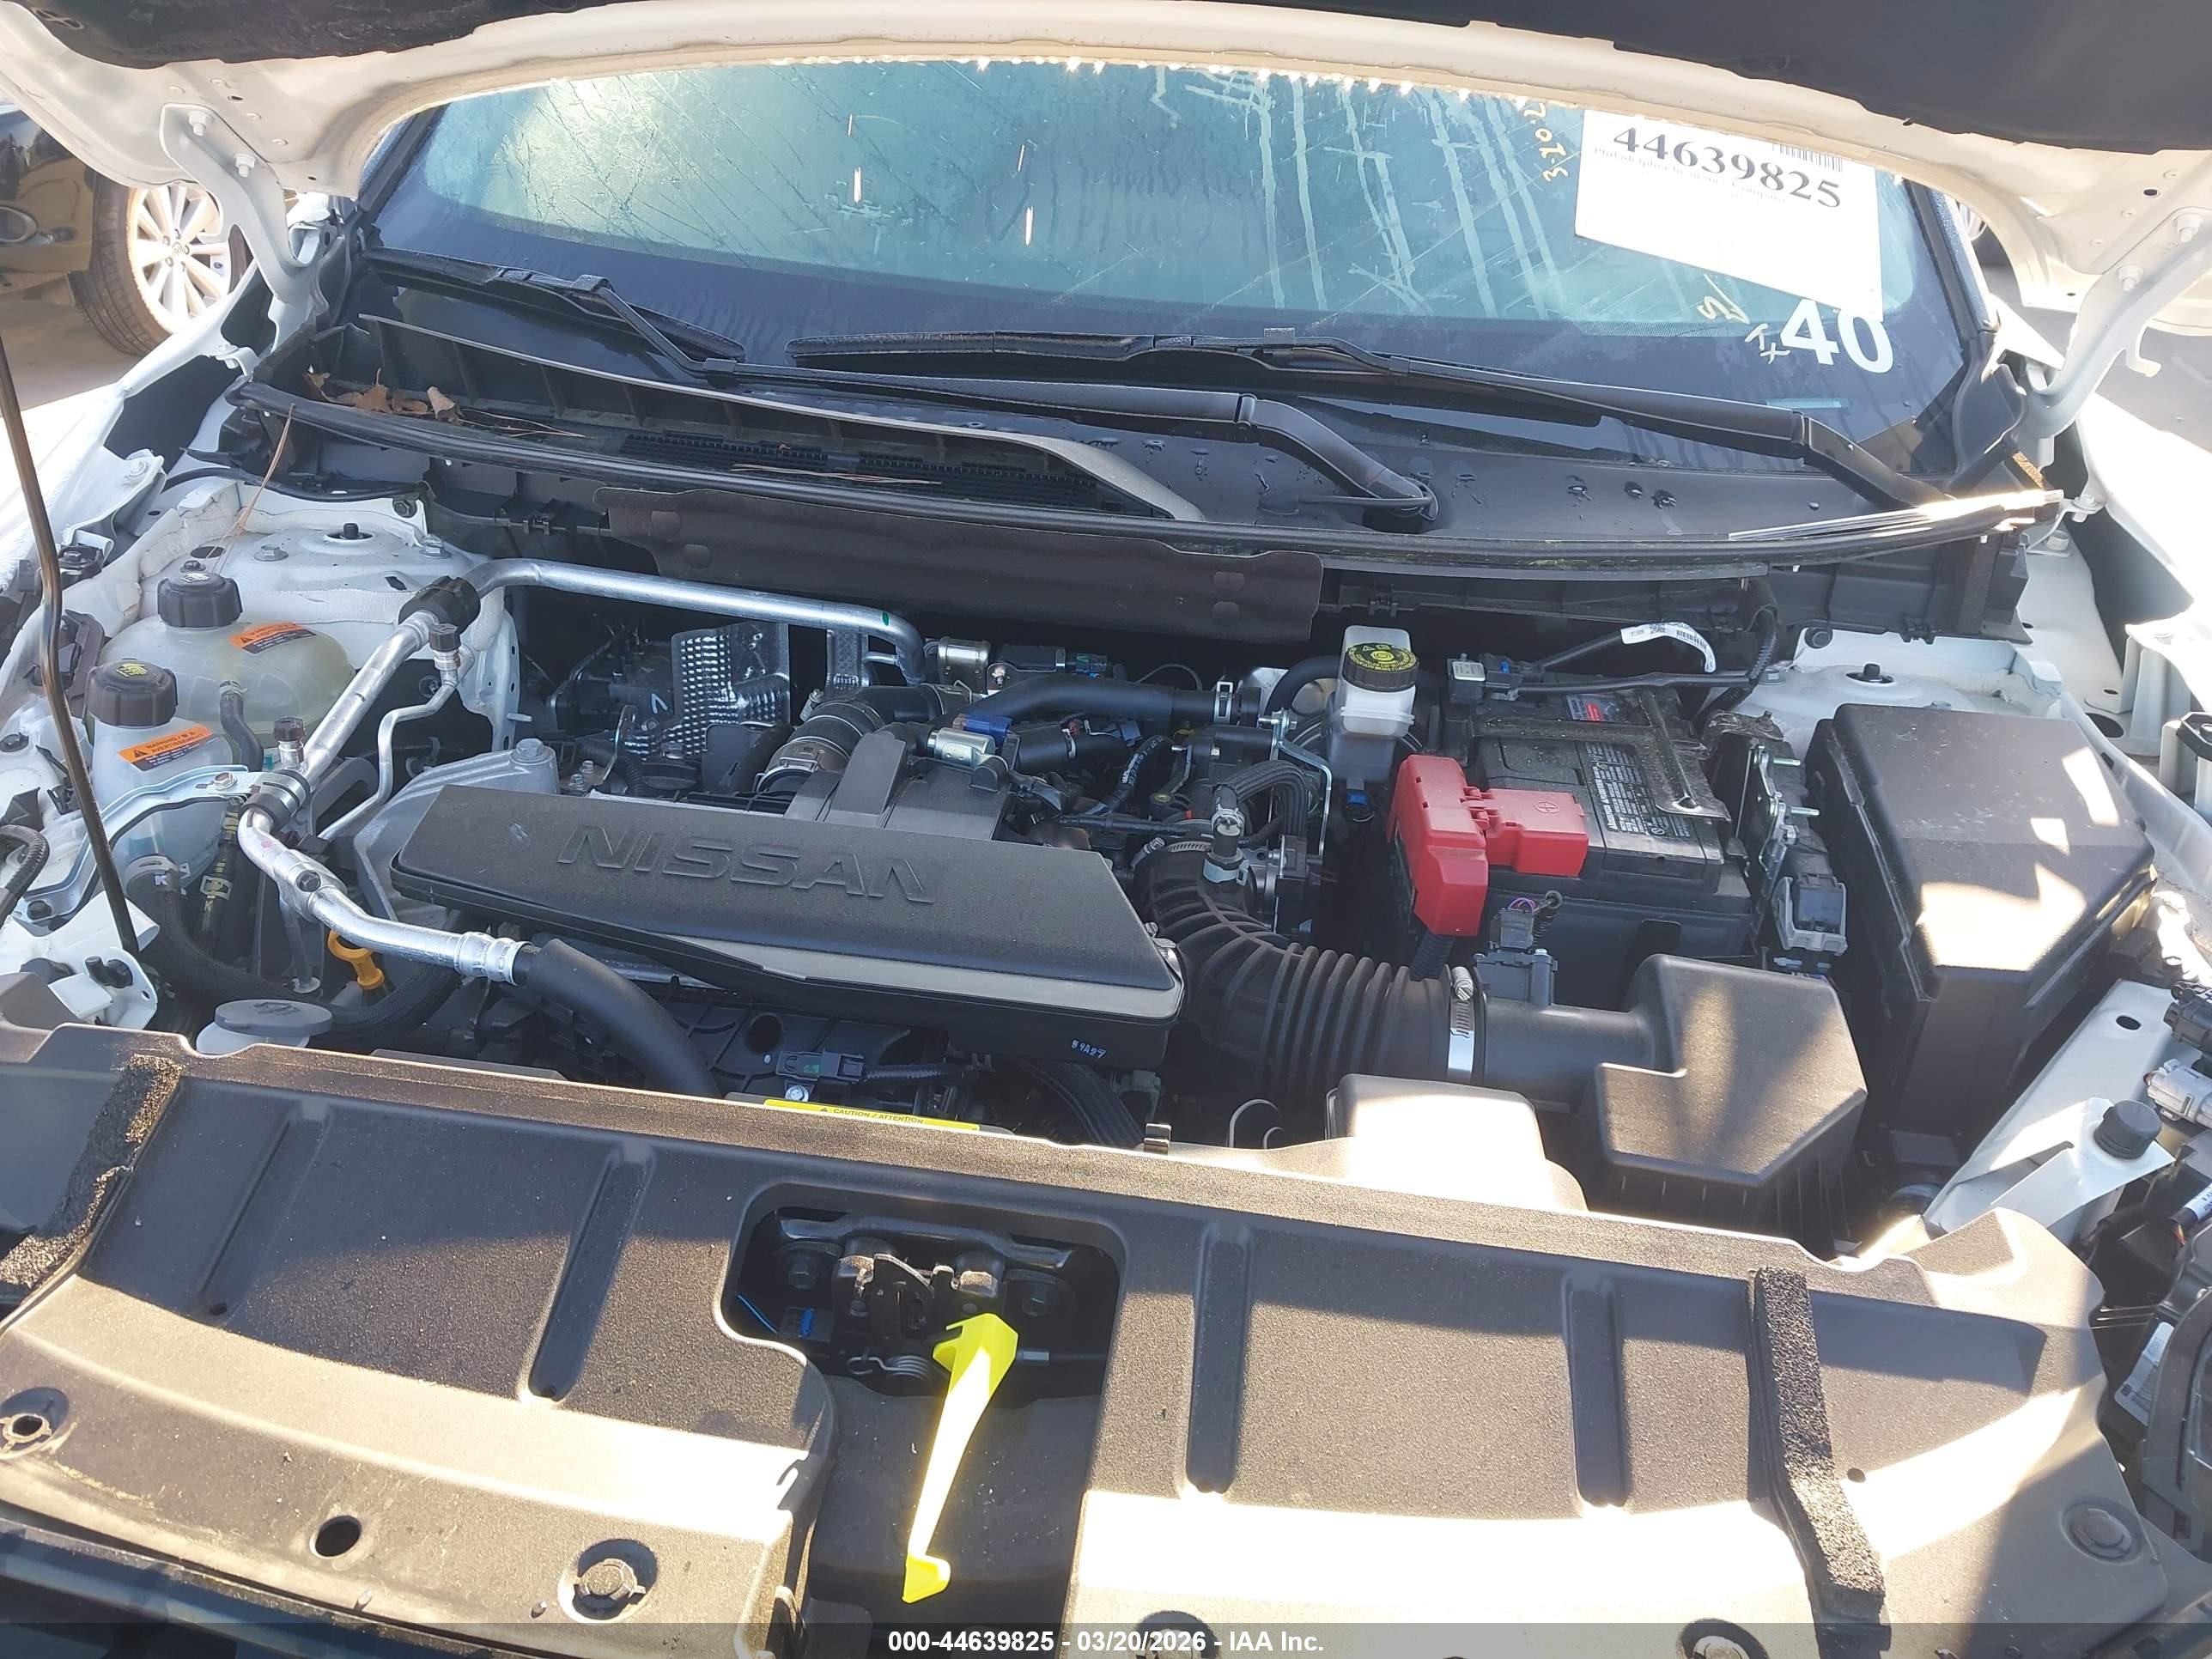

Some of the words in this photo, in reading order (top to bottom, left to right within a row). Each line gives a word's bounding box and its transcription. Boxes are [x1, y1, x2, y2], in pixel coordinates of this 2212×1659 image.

[1613, 126, 1841, 208] 44639825
[1780, 298, 1893, 374] 40
[556, 825, 935, 903] NISSAN
[833, 1108, 871, 1118] CAUTION
[878, 1114, 924, 1125] ATTENTION
